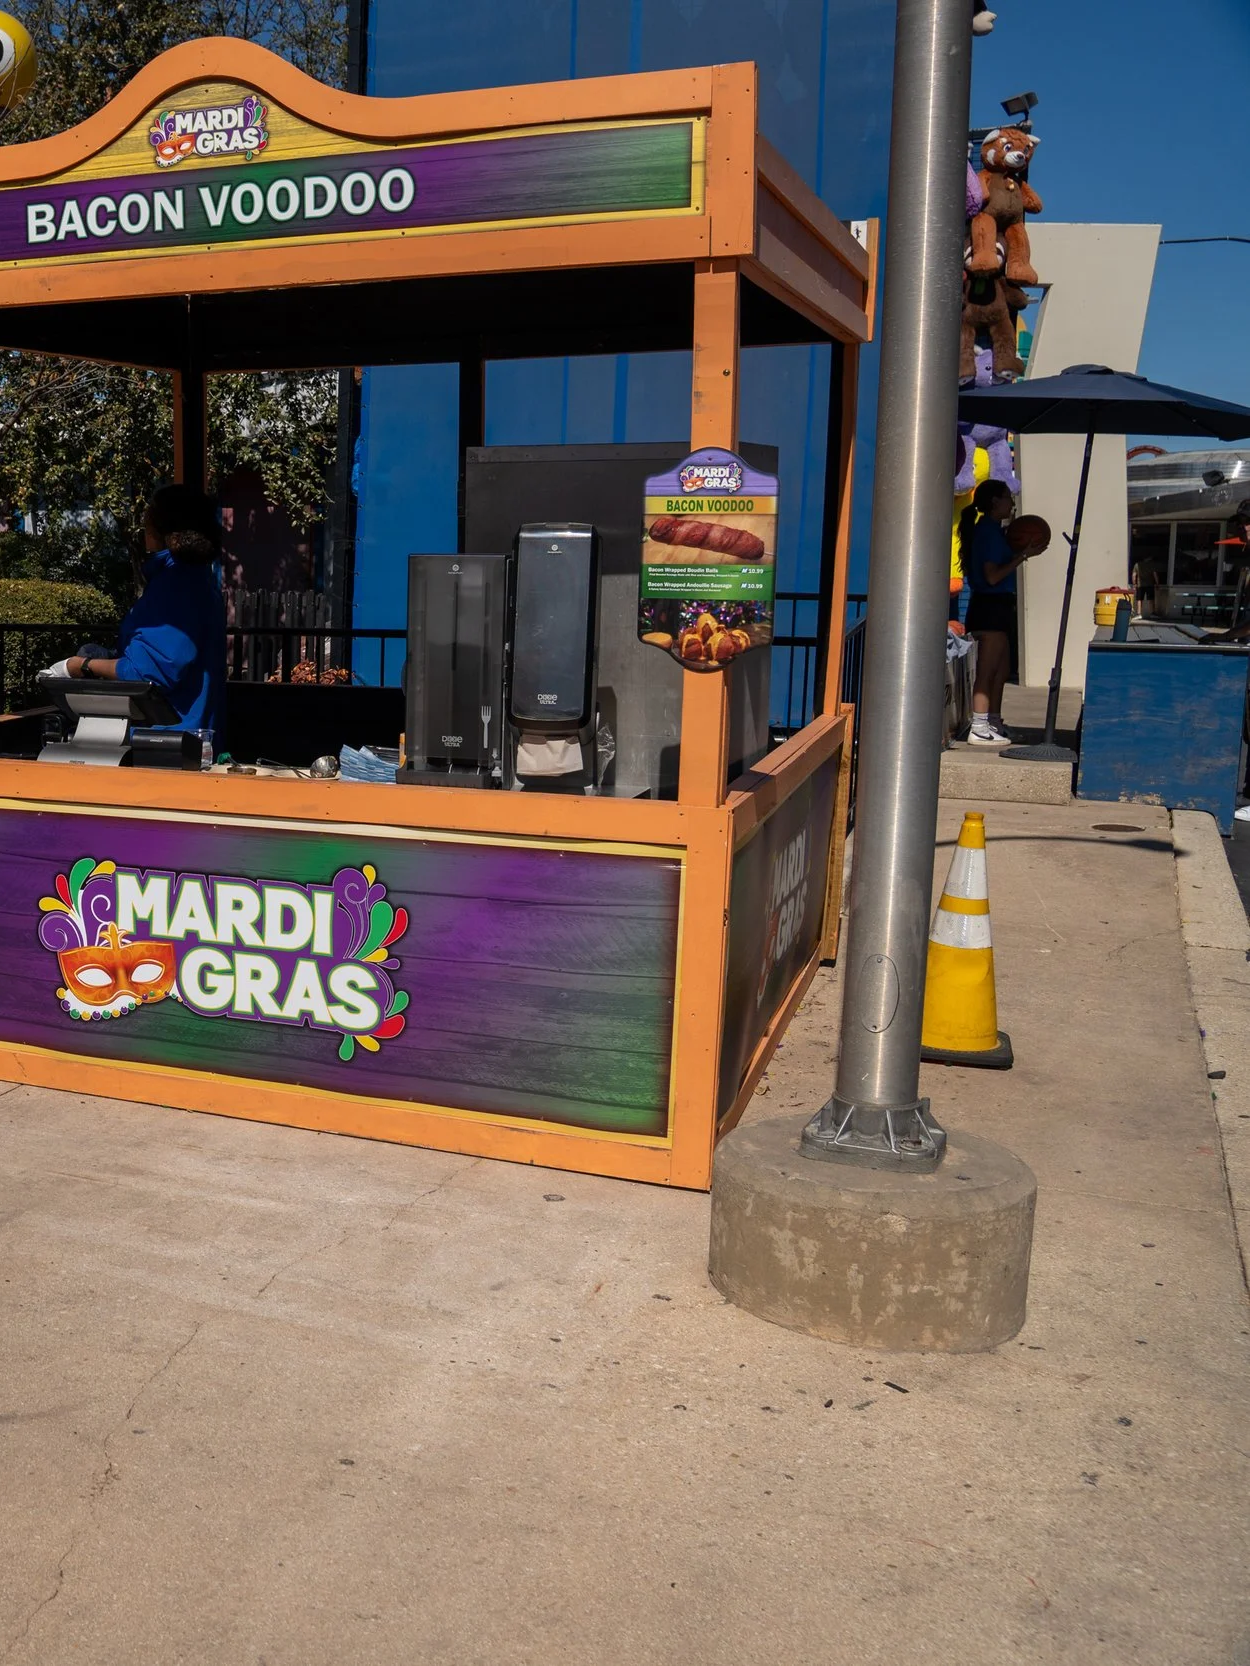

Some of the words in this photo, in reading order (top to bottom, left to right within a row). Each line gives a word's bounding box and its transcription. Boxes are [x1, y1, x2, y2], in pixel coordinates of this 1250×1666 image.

[175, 107, 244, 135] MARDI
[196, 127, 260, 154] GRAS
[26, 188, 186, 244] BACON
[198, 167, 416, 227] VOODOO
[693, 466, 730, 478] MARDI
[703, 477, 737, 488] GRAS
[666, 499, 703, 512] BACON
[707, 499, 754, 512] VOODOO
[771, 829, 806, 912] MARDI
[115, 871, 335, 955] MARDI
[776, 880, 807, 960] GRAS
[179, 947, 382, 1031] GRAS
